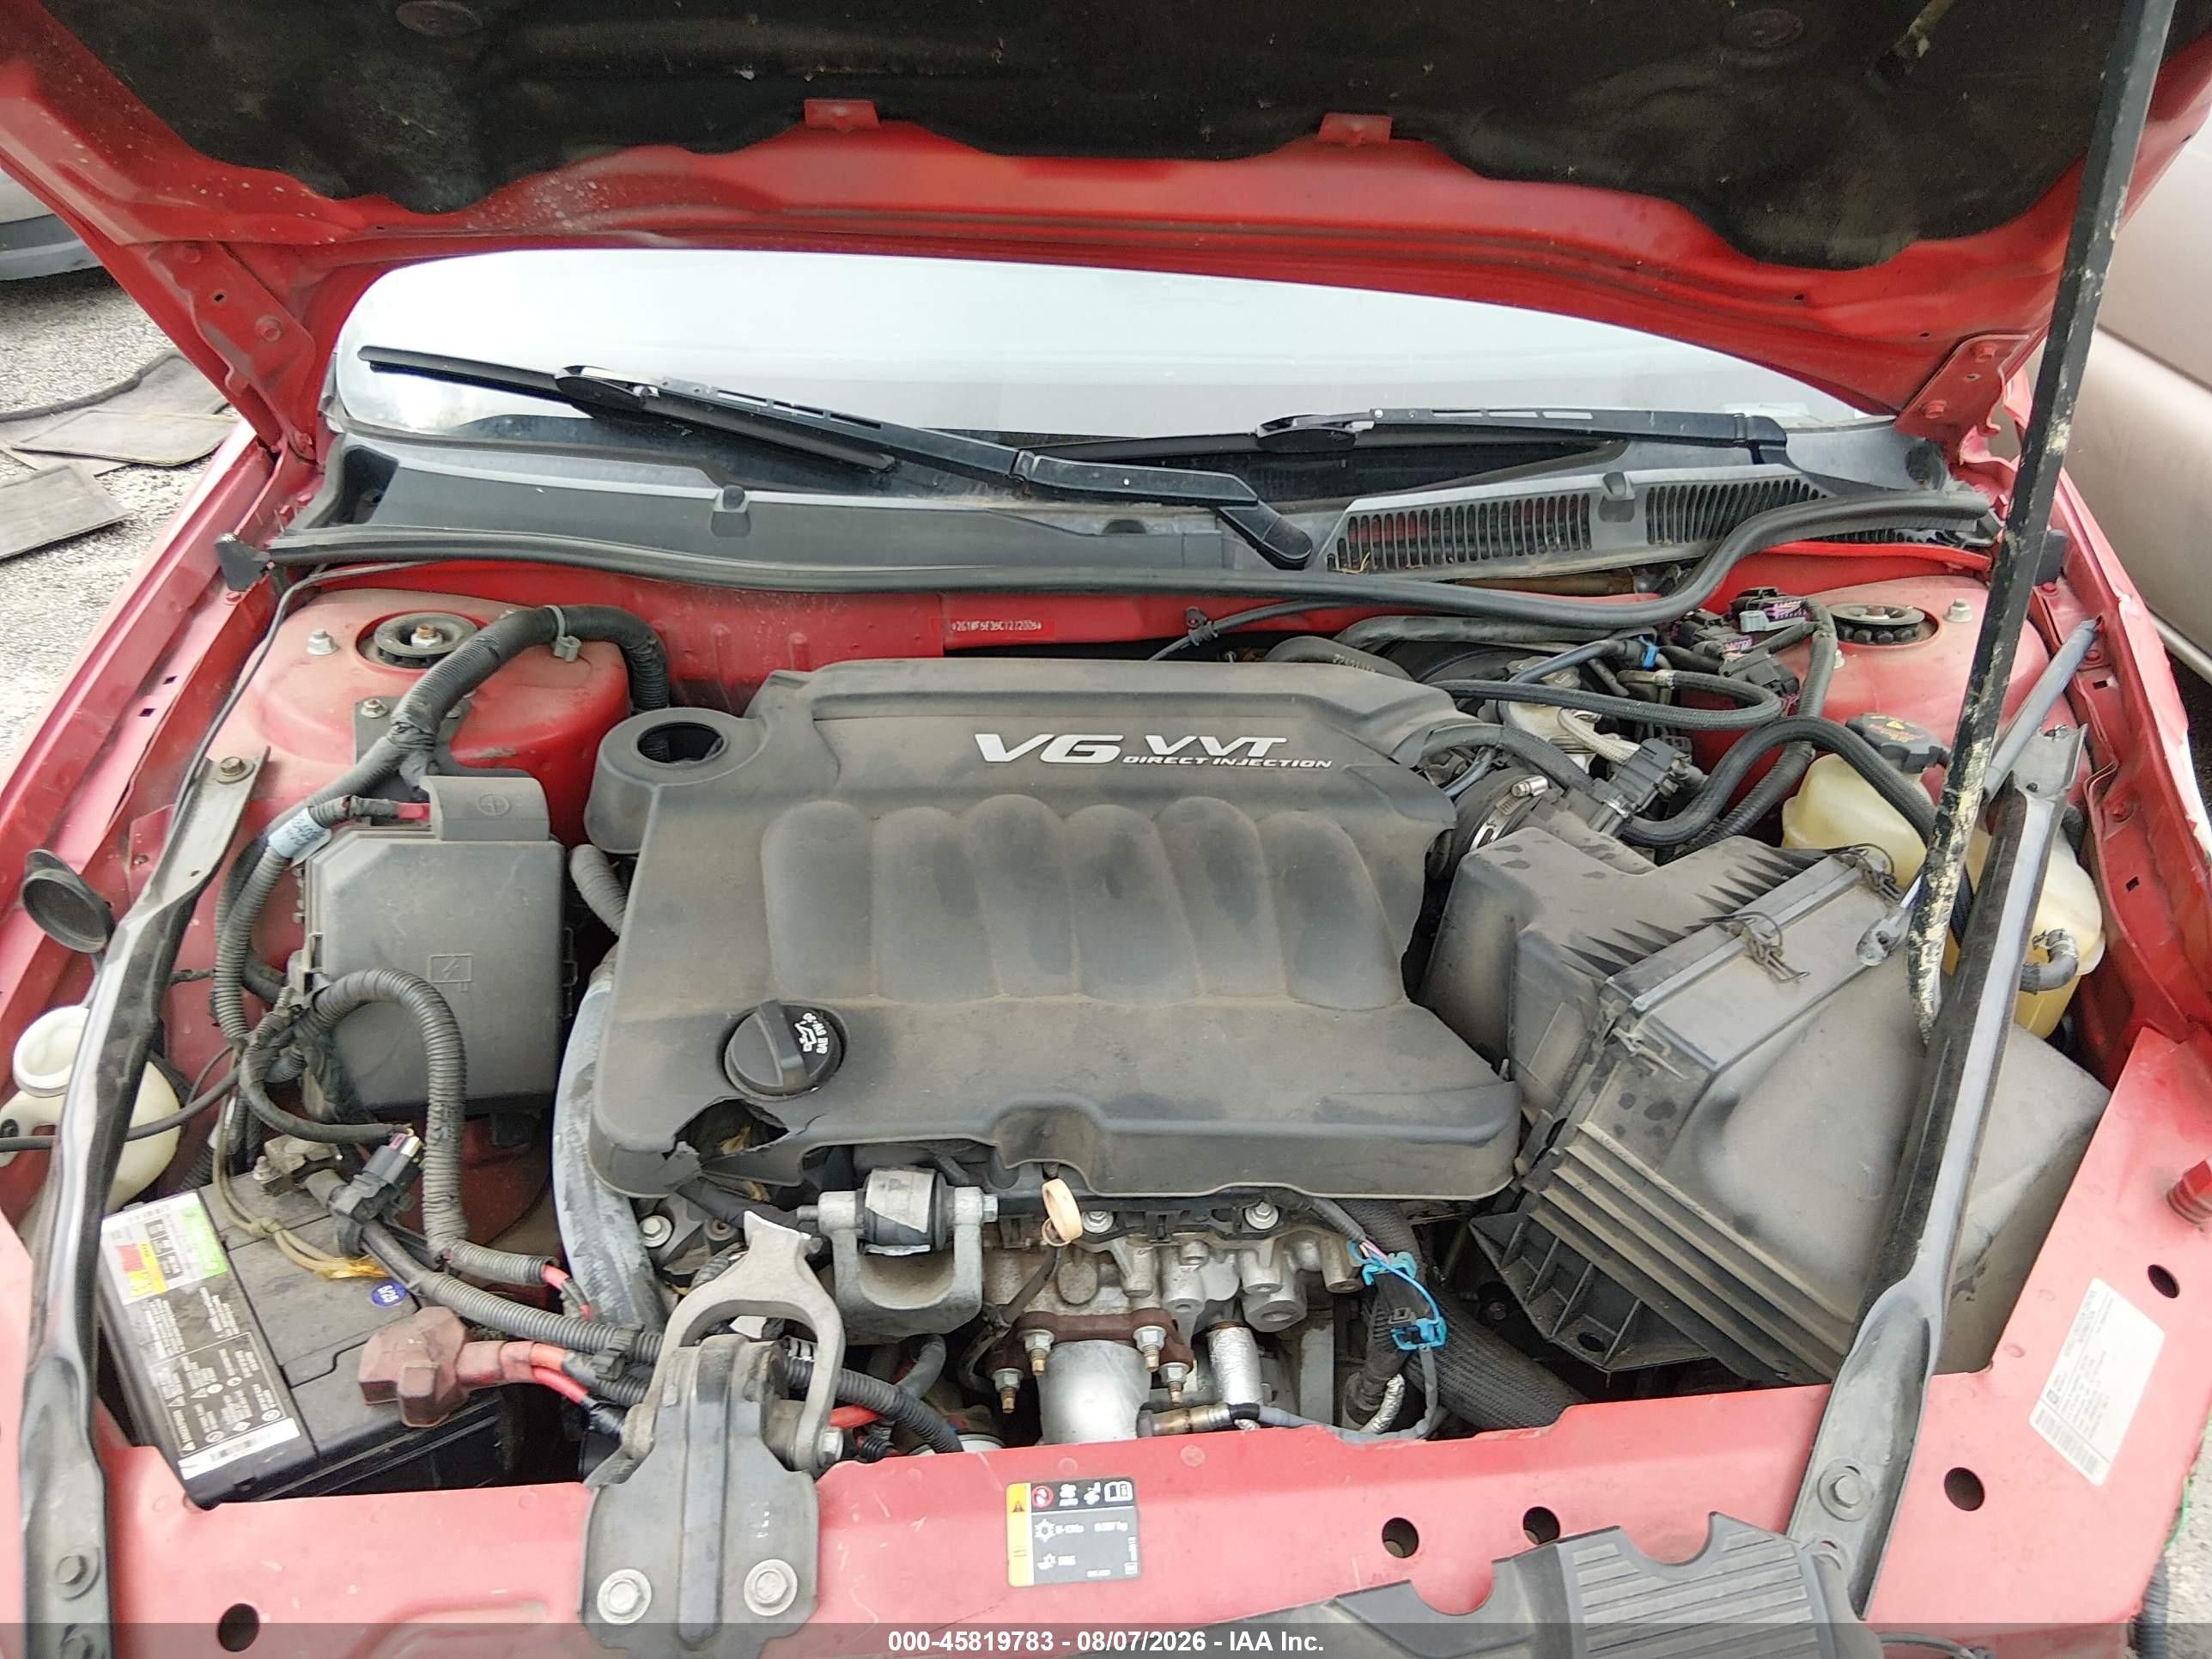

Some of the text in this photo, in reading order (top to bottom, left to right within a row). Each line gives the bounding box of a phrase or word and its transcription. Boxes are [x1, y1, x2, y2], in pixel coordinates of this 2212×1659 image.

[974, 732, 1288, 765] V6 VVT
[1121, 755, 1333, 769] DIRECT INJECTION
